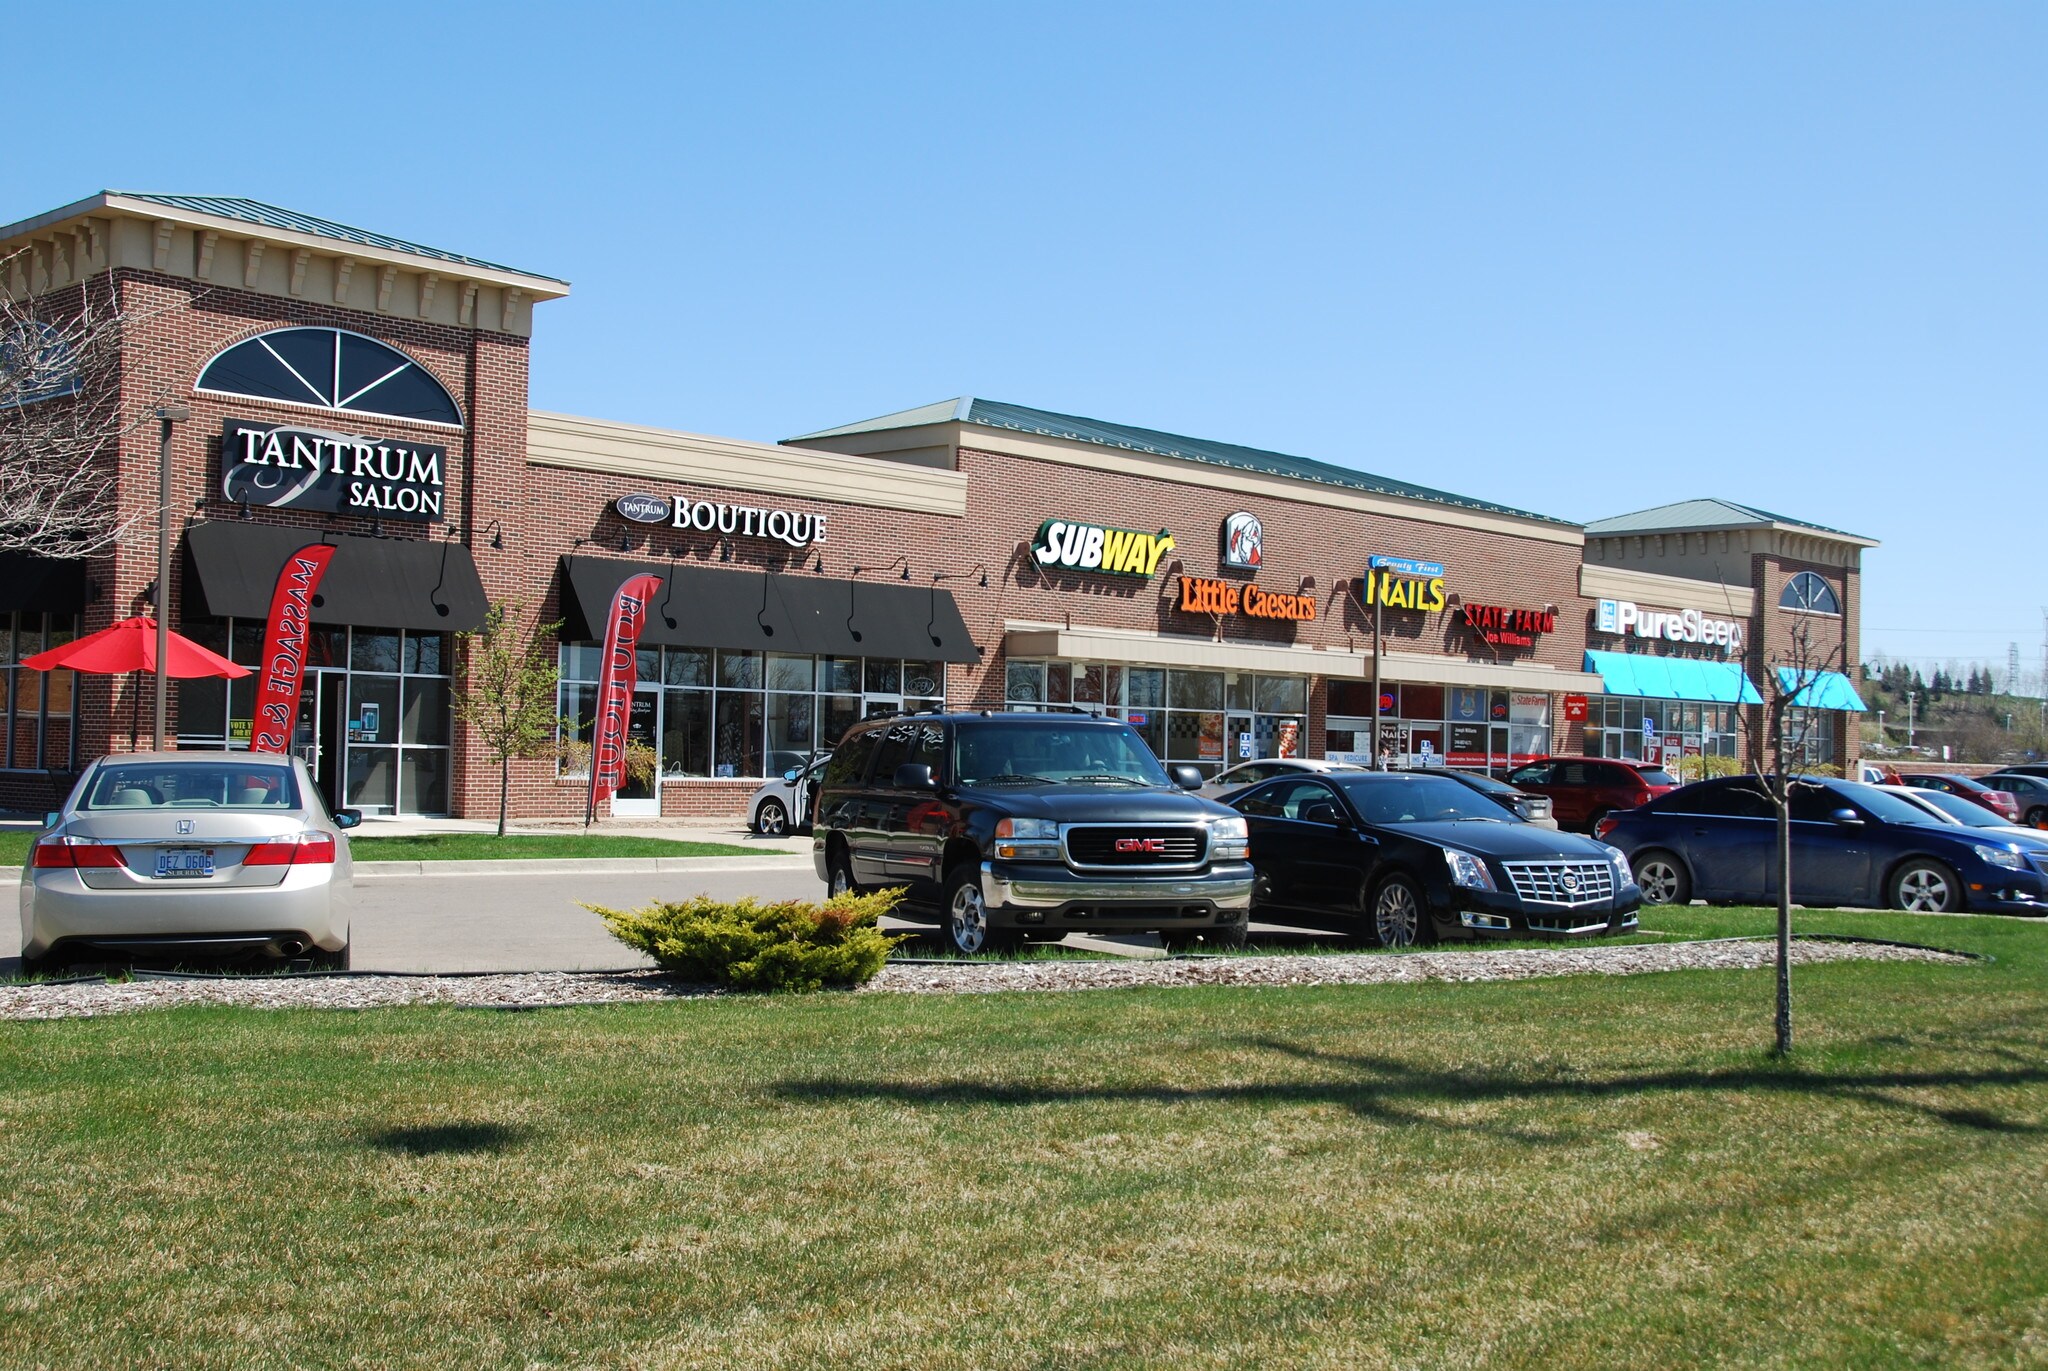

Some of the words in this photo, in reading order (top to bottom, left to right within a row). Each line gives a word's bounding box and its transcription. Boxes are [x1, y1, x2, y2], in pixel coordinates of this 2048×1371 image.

[237, 427, 443, 485] TANTRUM
[350, 482, 442, 515] SALON
[623, 502, 664, 516] TANTRUM
[671, 495, 827, 547] BOUTIQUE
[1036, 521, 1175, 575] SUBWAY
[1377, 558, 1412, 571] Beauty
[1415, 563, 1439, 573] First
[1180, 576, 1239, 614] Little
[1243, 584, 1316, 621] Caesars
[1367, 570, 1445, 612] NAILS
[1464, 603, 1508, 630] STATE
[1515, 610, 1554, 634] FARM
[1618, 600, 1743, 654] PureSleep
[1486, 631, 1498, 643] Joe
[1500, 632, 1532, 646] Williams
[230, 721, 246, 729] VOTE
[1328, 754, 1338, 762] SPA
[1344, 754, 1368, 763] PEDICURE
[1115, 838, 1165, 852] GMC
[160, 855, 179, 869] DEZ
[185, 855, 212, 869] 0606
